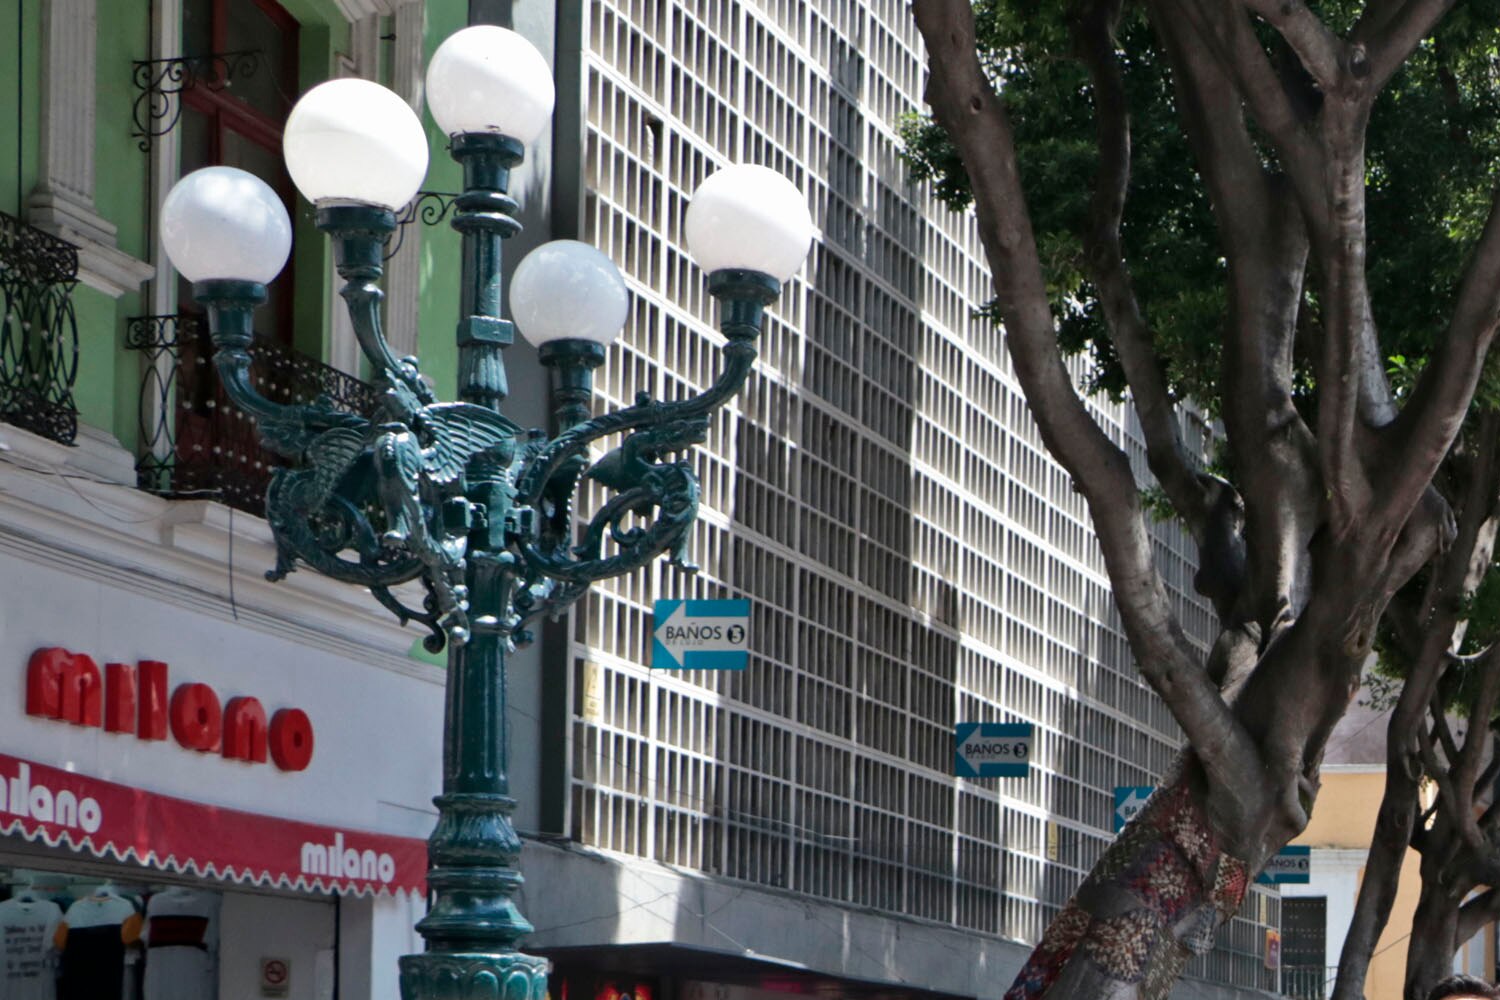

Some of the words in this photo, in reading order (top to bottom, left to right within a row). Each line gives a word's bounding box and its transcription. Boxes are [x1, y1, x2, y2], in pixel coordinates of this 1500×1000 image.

[665, 621, 722, 640] BAÑOS
[26, 647, 314, 771] milano
[965, 740, 1010, 755] BAÑOS
[301, 832, 395, 884] milano
